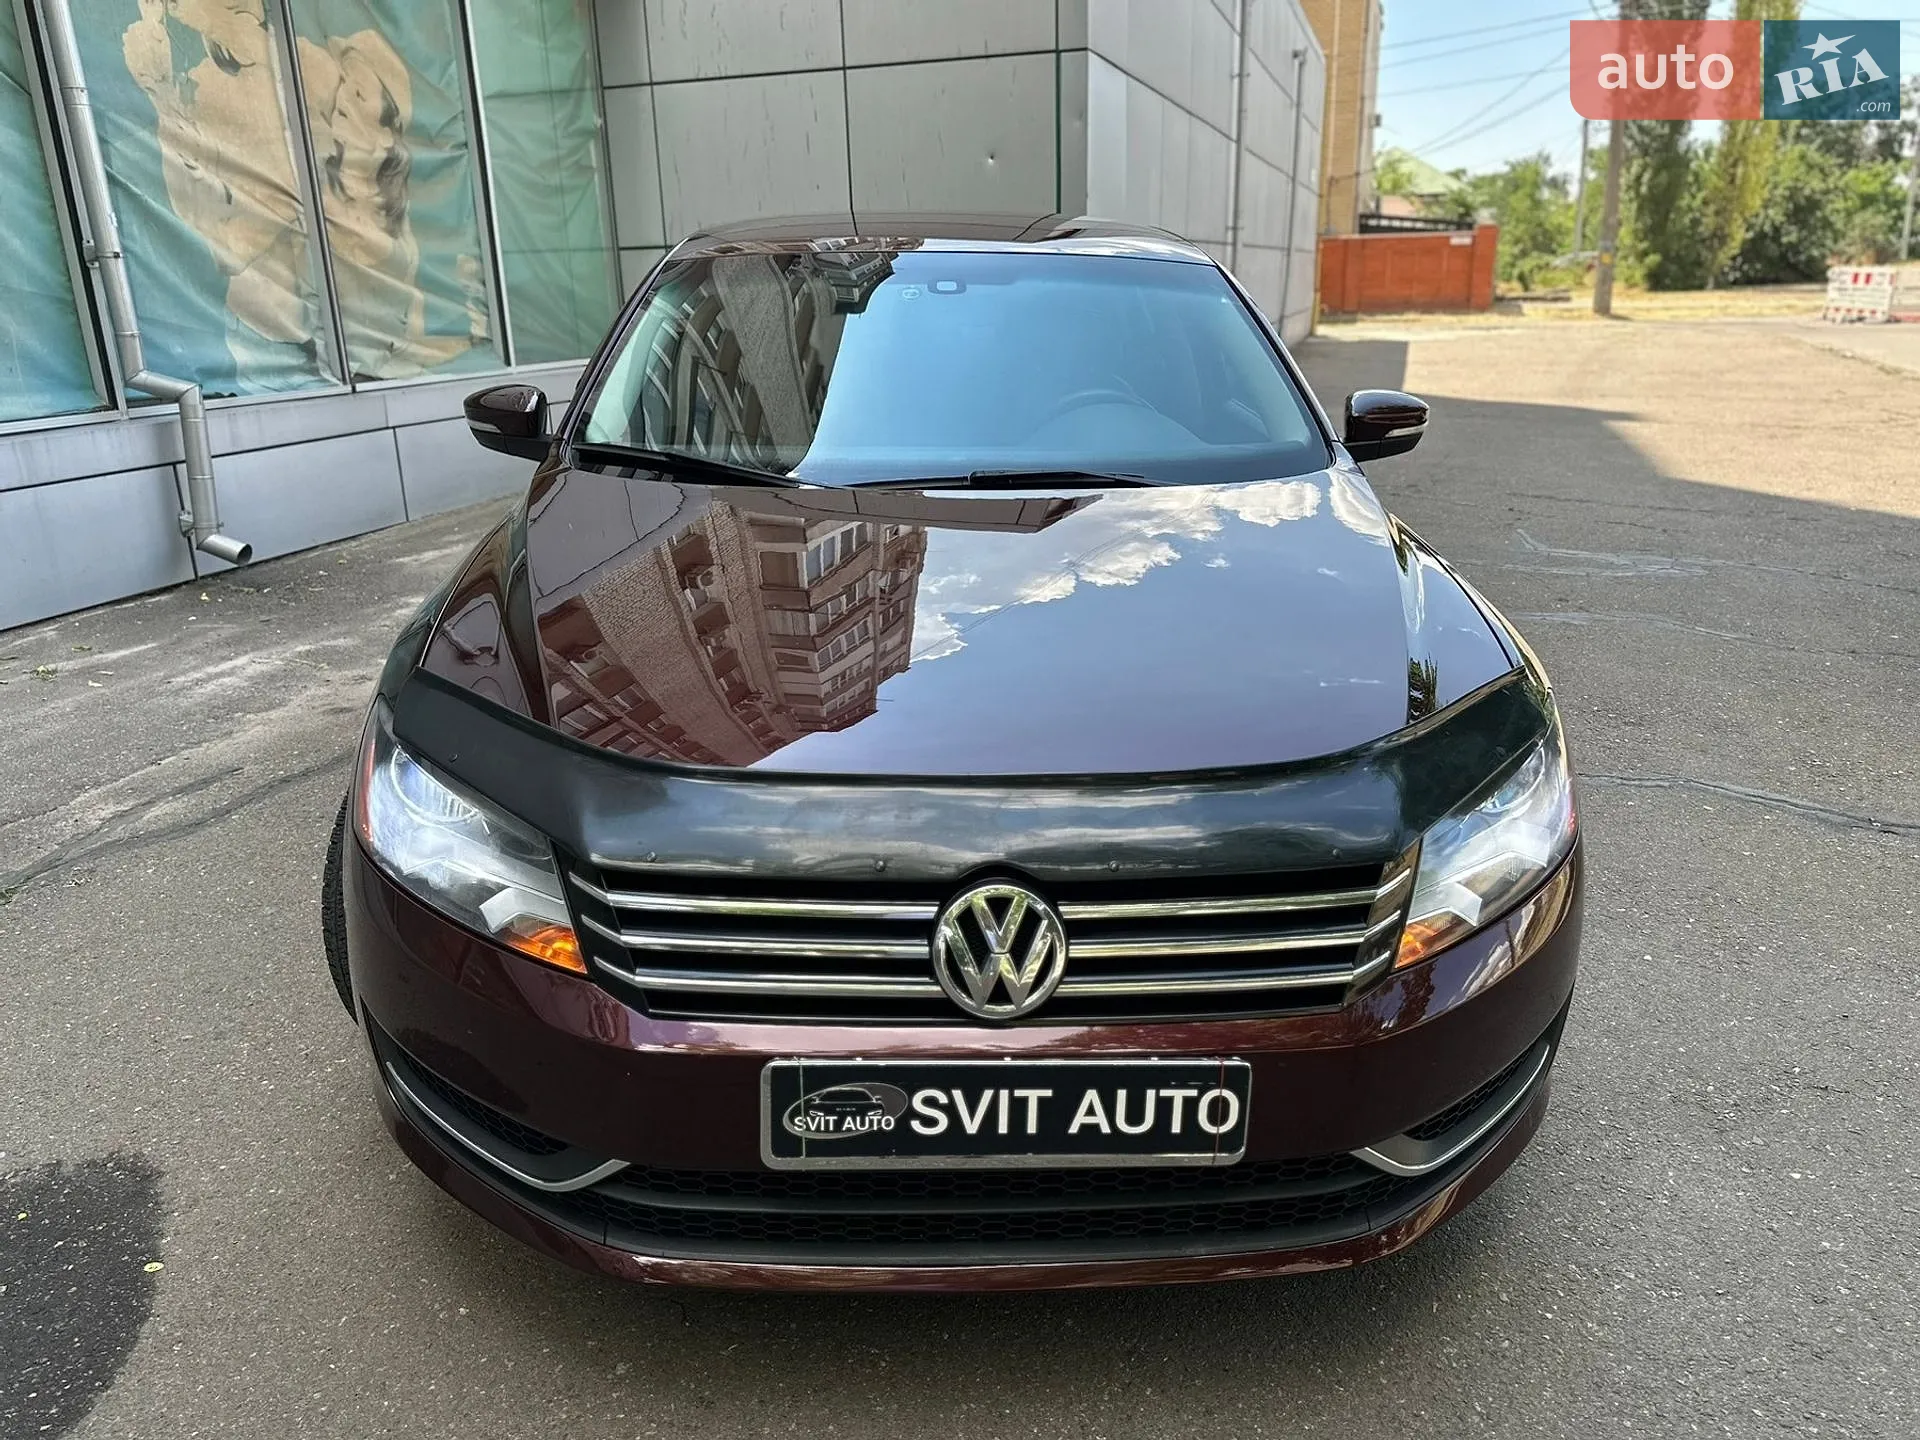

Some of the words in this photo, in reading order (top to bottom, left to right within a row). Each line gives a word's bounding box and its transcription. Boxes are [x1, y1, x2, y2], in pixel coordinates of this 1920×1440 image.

[793, 1115, 838, 1131] SVIT
[842, 1115, 895, 1131] AUTO
[910, 1088, 1052, 1135] SVIT
[1068, 1088, 1240, 1135] AUTO
